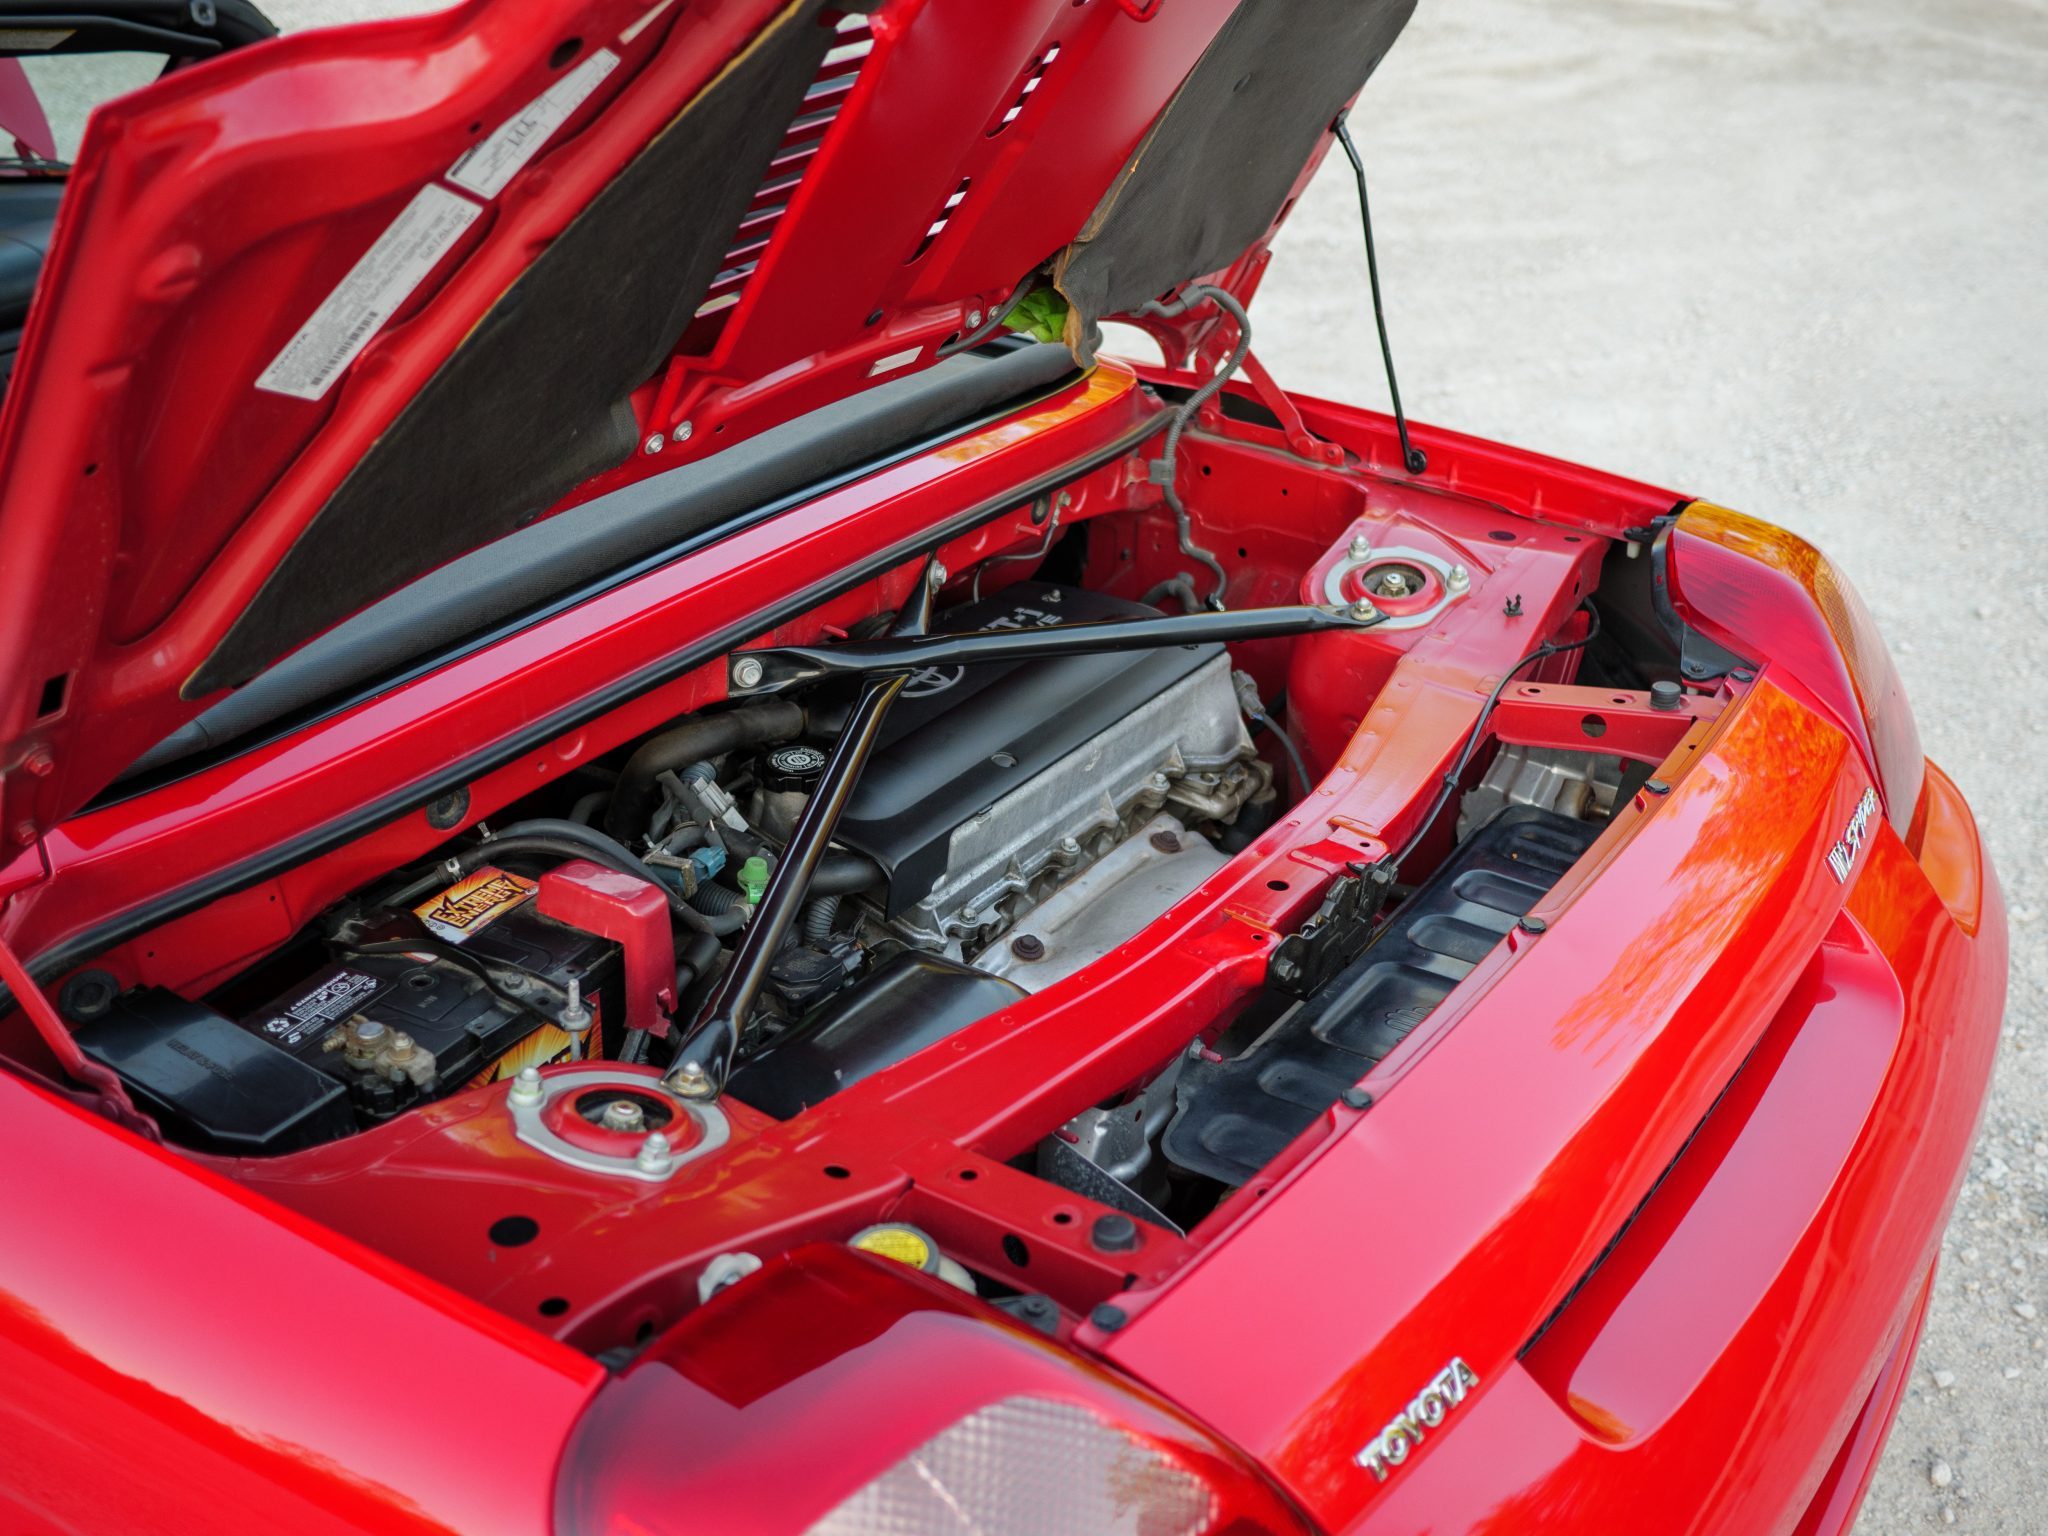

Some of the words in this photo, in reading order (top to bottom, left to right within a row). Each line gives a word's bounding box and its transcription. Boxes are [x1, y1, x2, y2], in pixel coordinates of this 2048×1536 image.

[1845, 786, 1879, 862] SPYDER
[431, 878, 506, 923] EXTREME
[449, 880, 524, 928] ENERGY
[1355, 1356, 1480, 1482] TOYOTA
